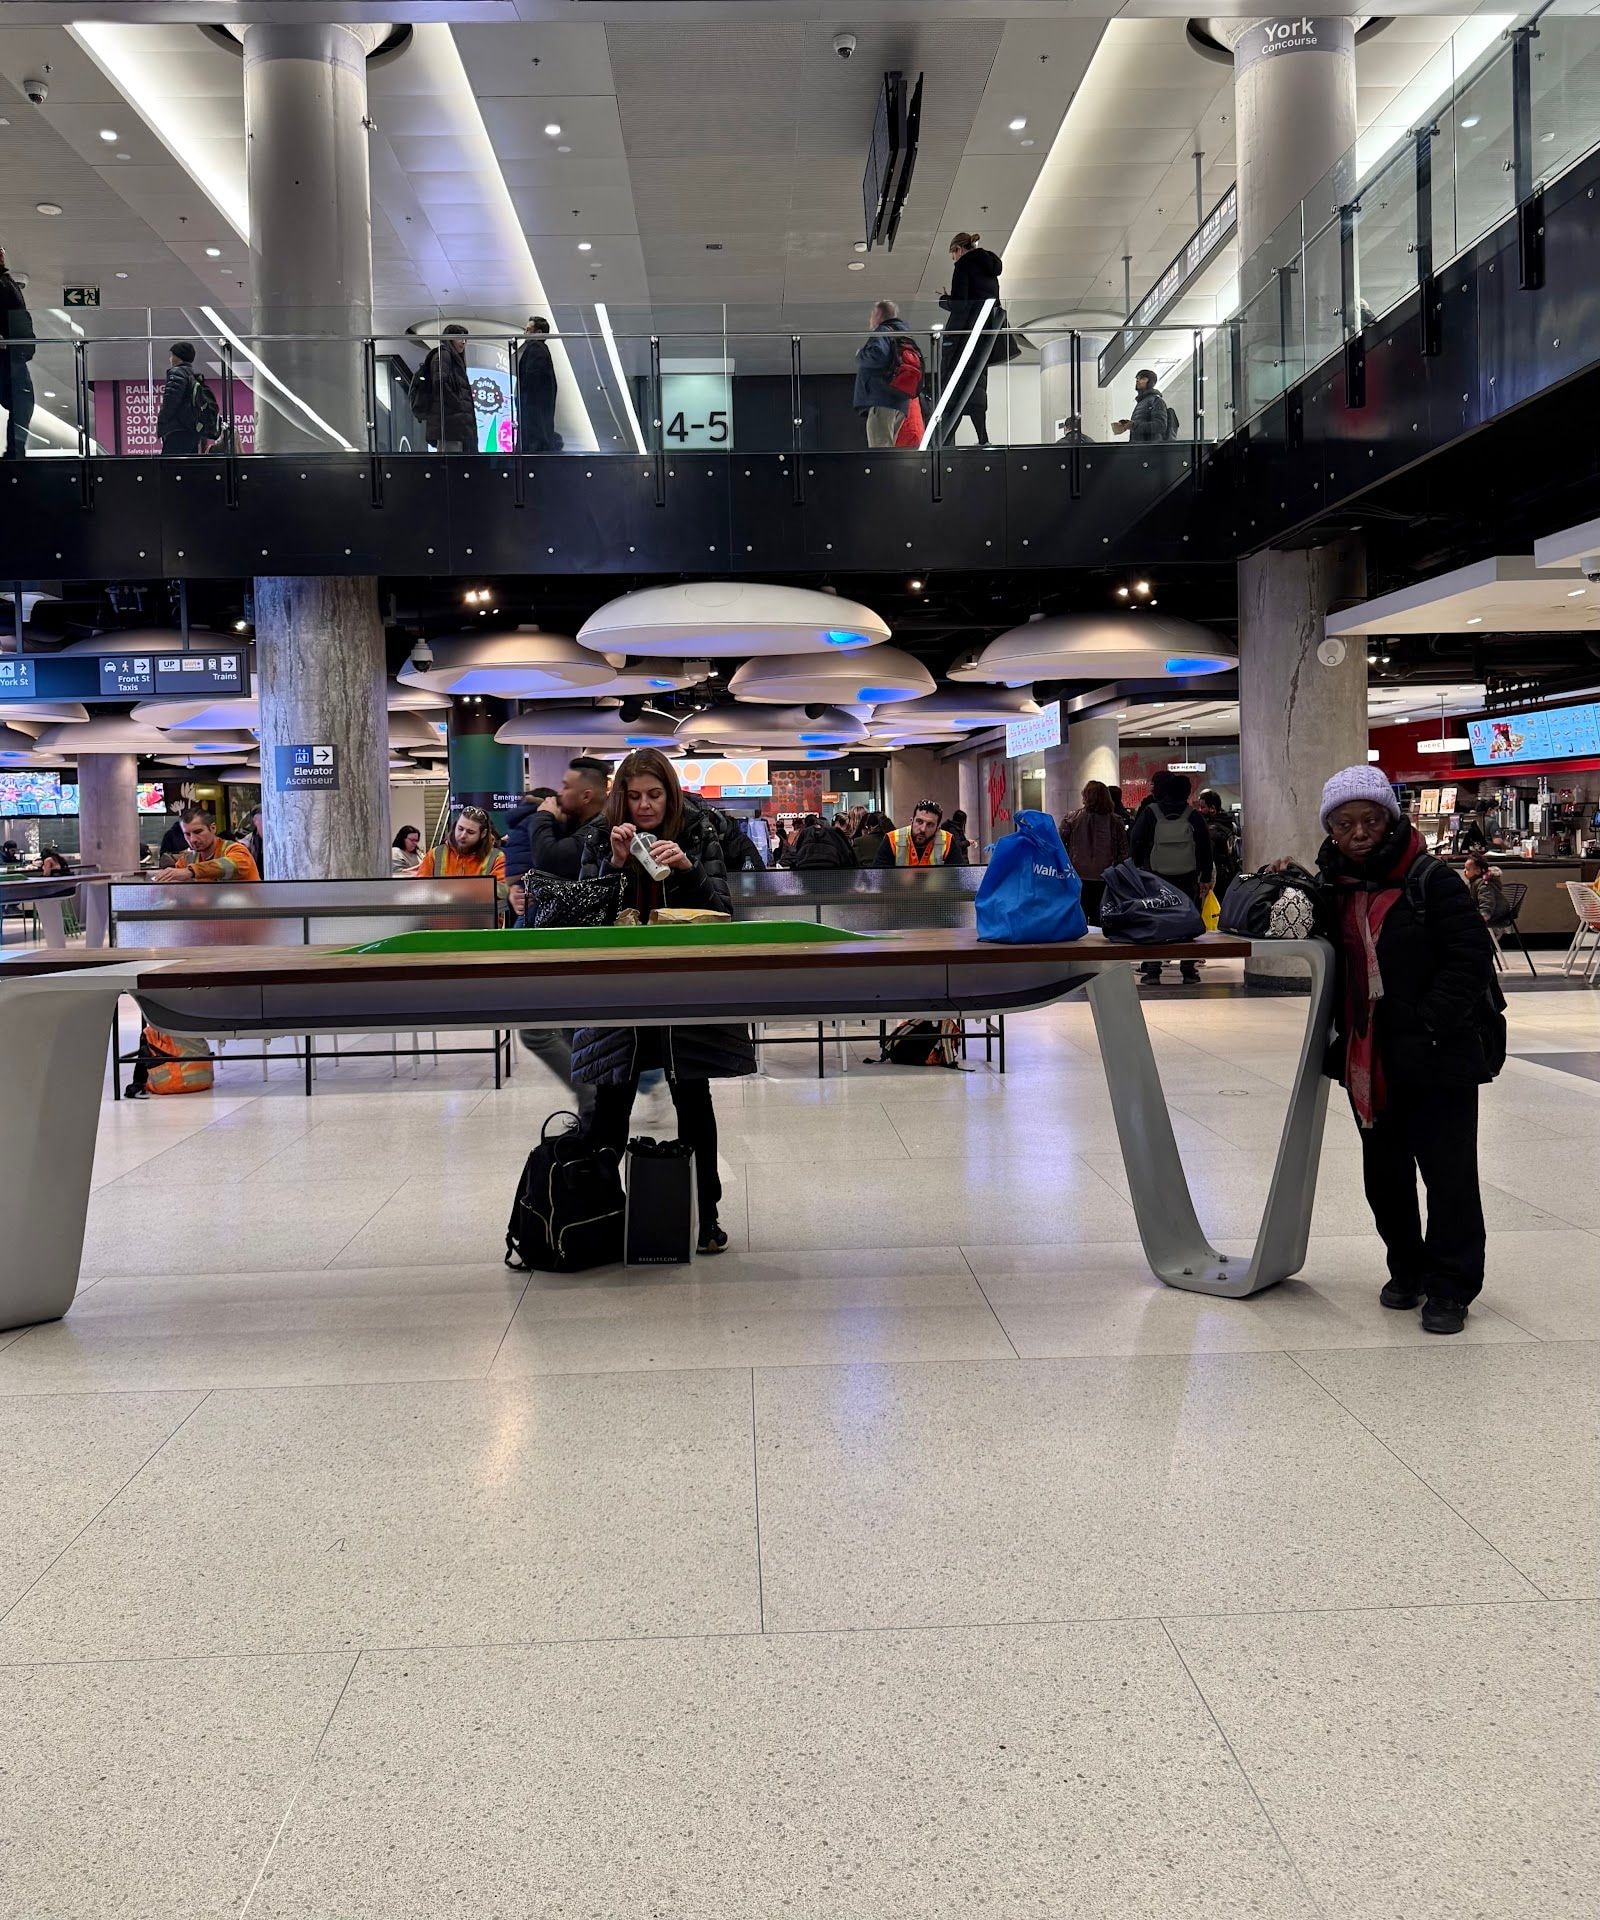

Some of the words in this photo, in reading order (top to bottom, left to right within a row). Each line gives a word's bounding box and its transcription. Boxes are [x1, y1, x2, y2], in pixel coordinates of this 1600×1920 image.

[1264, 16, 1314, 42] York
[1261, 37, 1318, 54] Concourse
[125, 395, 158, 404] CANT
[126, 405, 155, 414] YOUR
[126, 415, 141, 425] SO
[143, 415, 158, 425] YO
[126, 426, 157, 435] SHOU
[667, 411, 729, 443] 4-5
[127, 436, 157, 445] HOLD
[118, 675, 139, 683] Front
[141, 674, 150, 682] St
[213, 673, 237, 681] Trains
[0, 678, 18, 686] York
[20, 678, 29, 686] St
[294, 767, 333, 776] Elevator
[285, 776, 333, 785] Ascenseur
